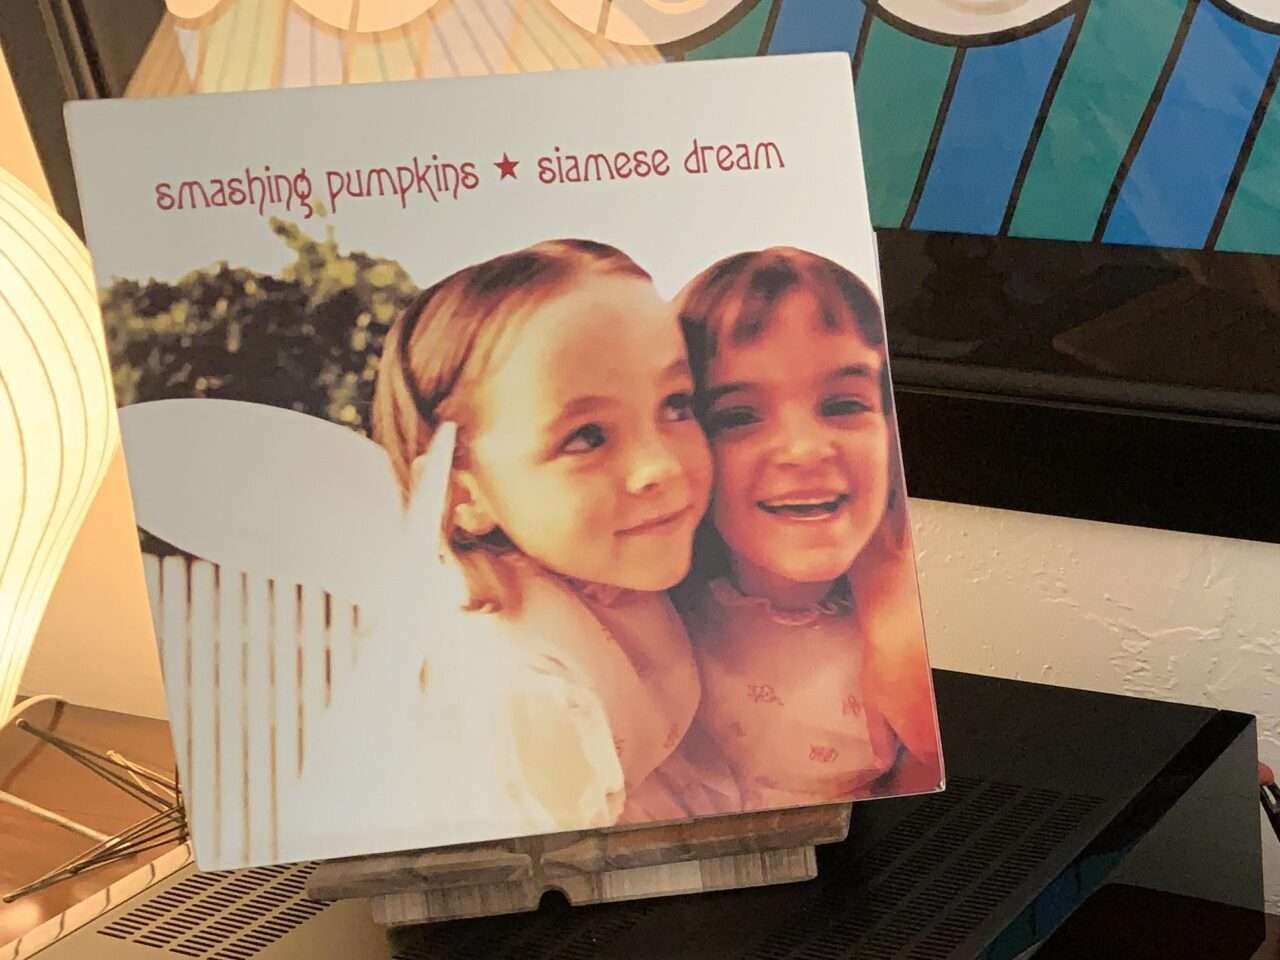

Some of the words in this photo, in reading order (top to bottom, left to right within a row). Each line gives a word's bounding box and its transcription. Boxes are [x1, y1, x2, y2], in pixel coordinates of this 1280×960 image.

[155, 165, 313, 219] smashing
[326, 154, 480, 215] pumpkins
[537, 146, 670, 184] siamese
[684, 138, 785, 174] dream
